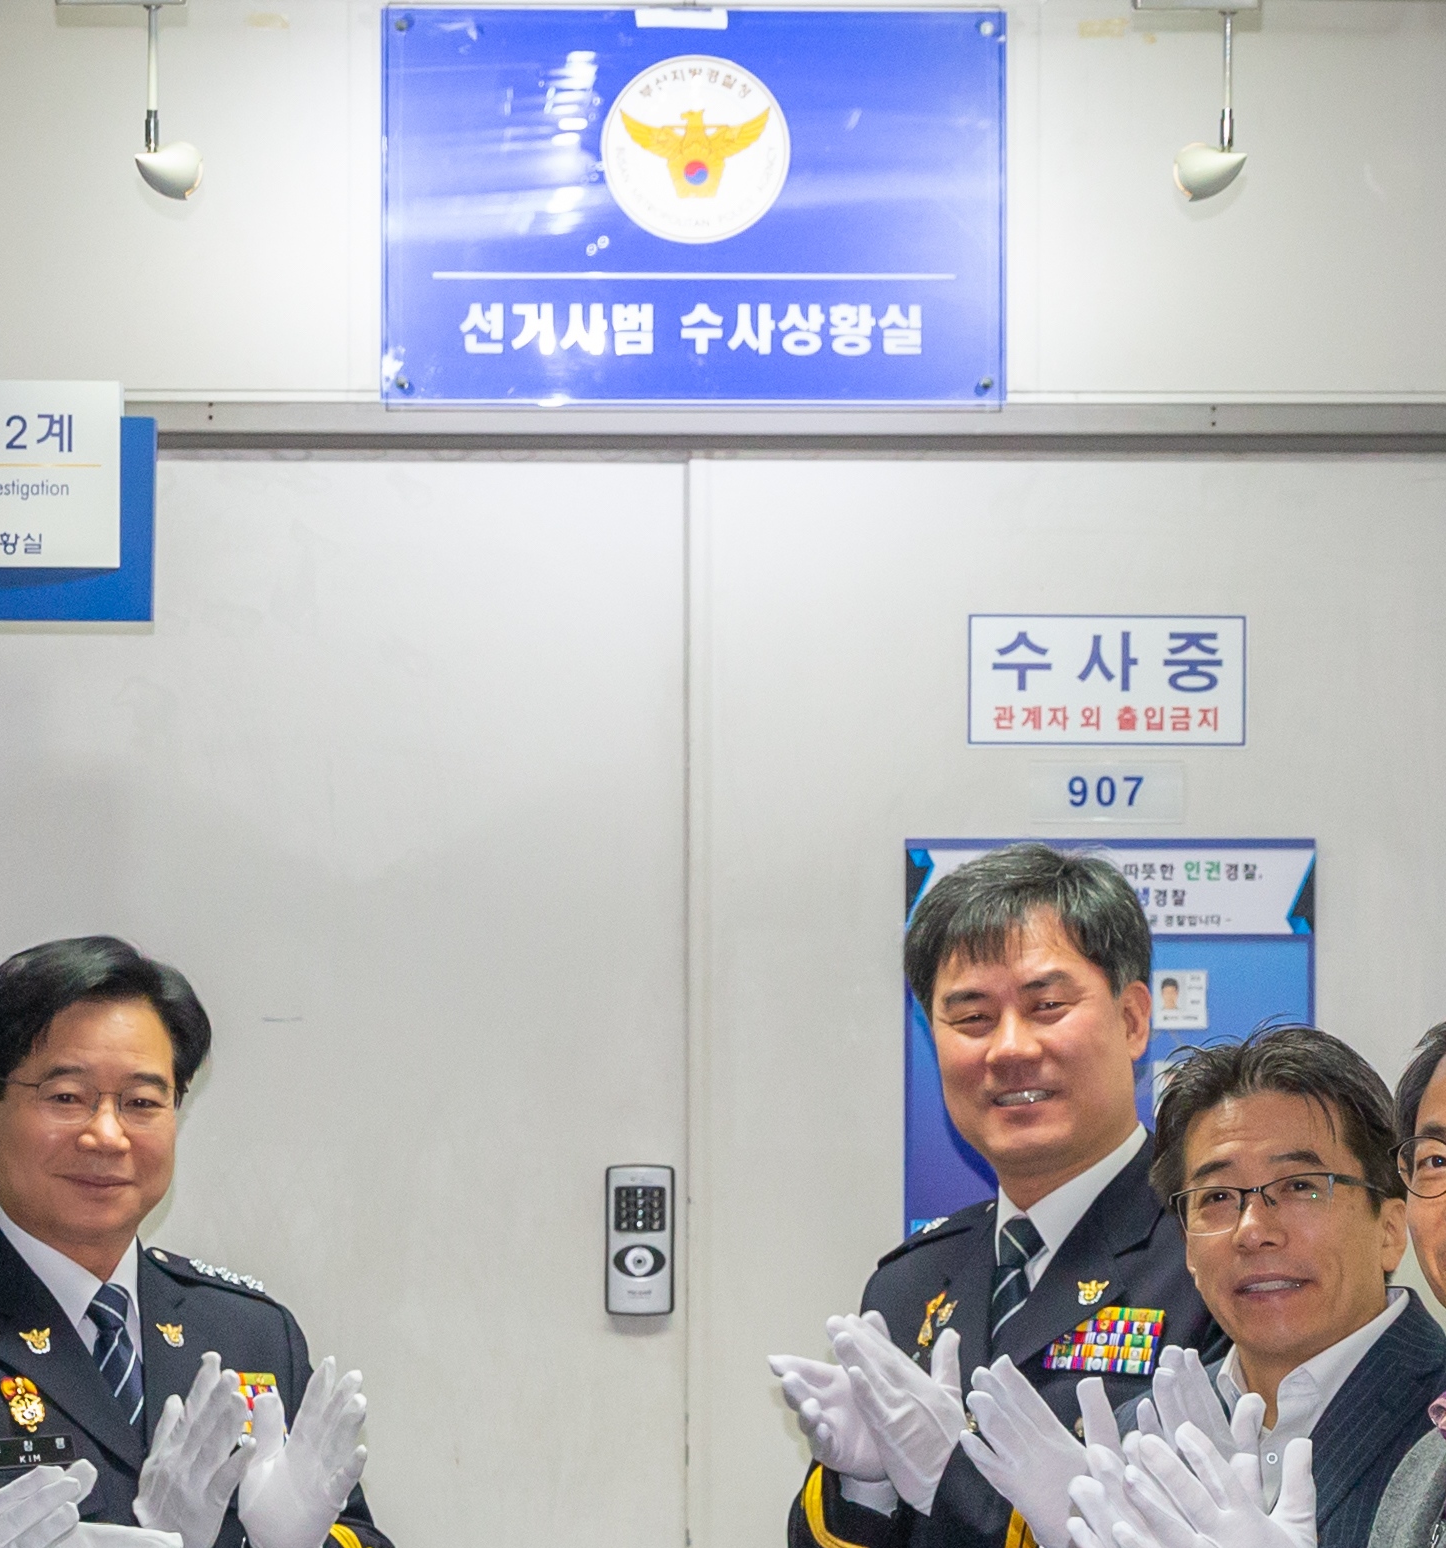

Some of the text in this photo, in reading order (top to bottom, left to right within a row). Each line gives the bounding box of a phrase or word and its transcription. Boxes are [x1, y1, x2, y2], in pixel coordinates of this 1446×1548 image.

[459, 303, 923, 356] 선거사범 수사상황실
[5, 414, 73, 453] 2계
[993, 705, 1219, 732] 관계자 외 출입금지
[1068, 775, 1144, 808] 907
[19, 1454, 42, 1464] KIM
